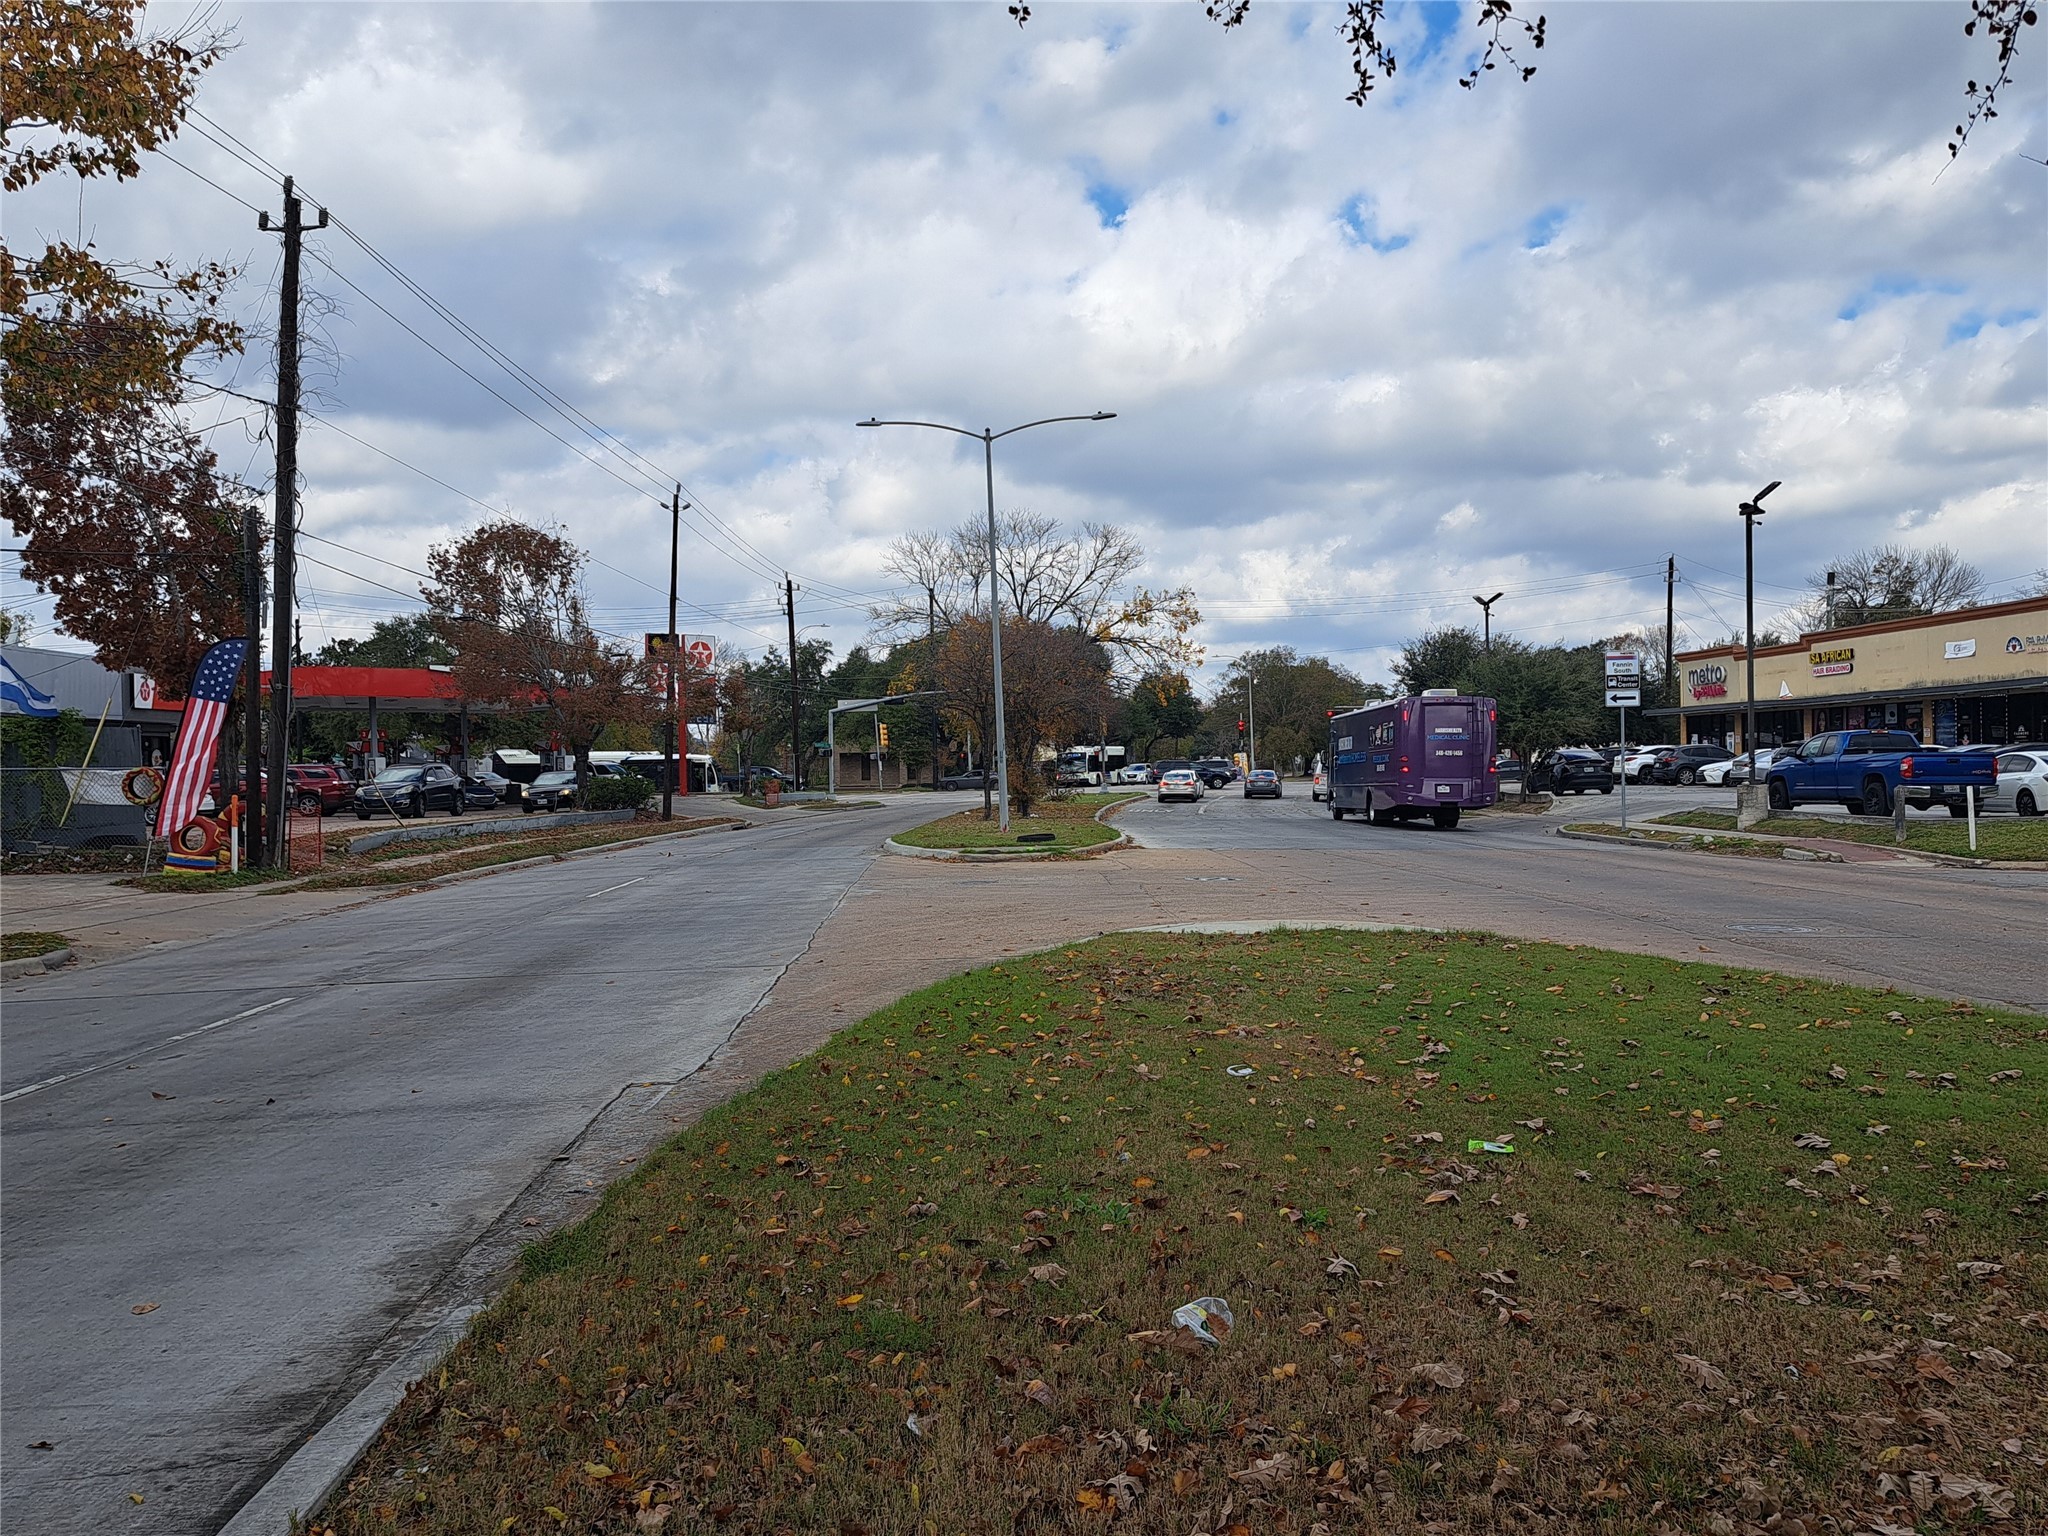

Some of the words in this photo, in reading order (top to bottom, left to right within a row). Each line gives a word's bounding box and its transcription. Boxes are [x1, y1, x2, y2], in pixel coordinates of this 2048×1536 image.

[1821, 648, 1851, 662] AFRICAN
[1688, 664, 1722, 685] metro
[1813, 667, 1824, 675] HAIR
[1825, 664, 1850, 673] BRAIDING
